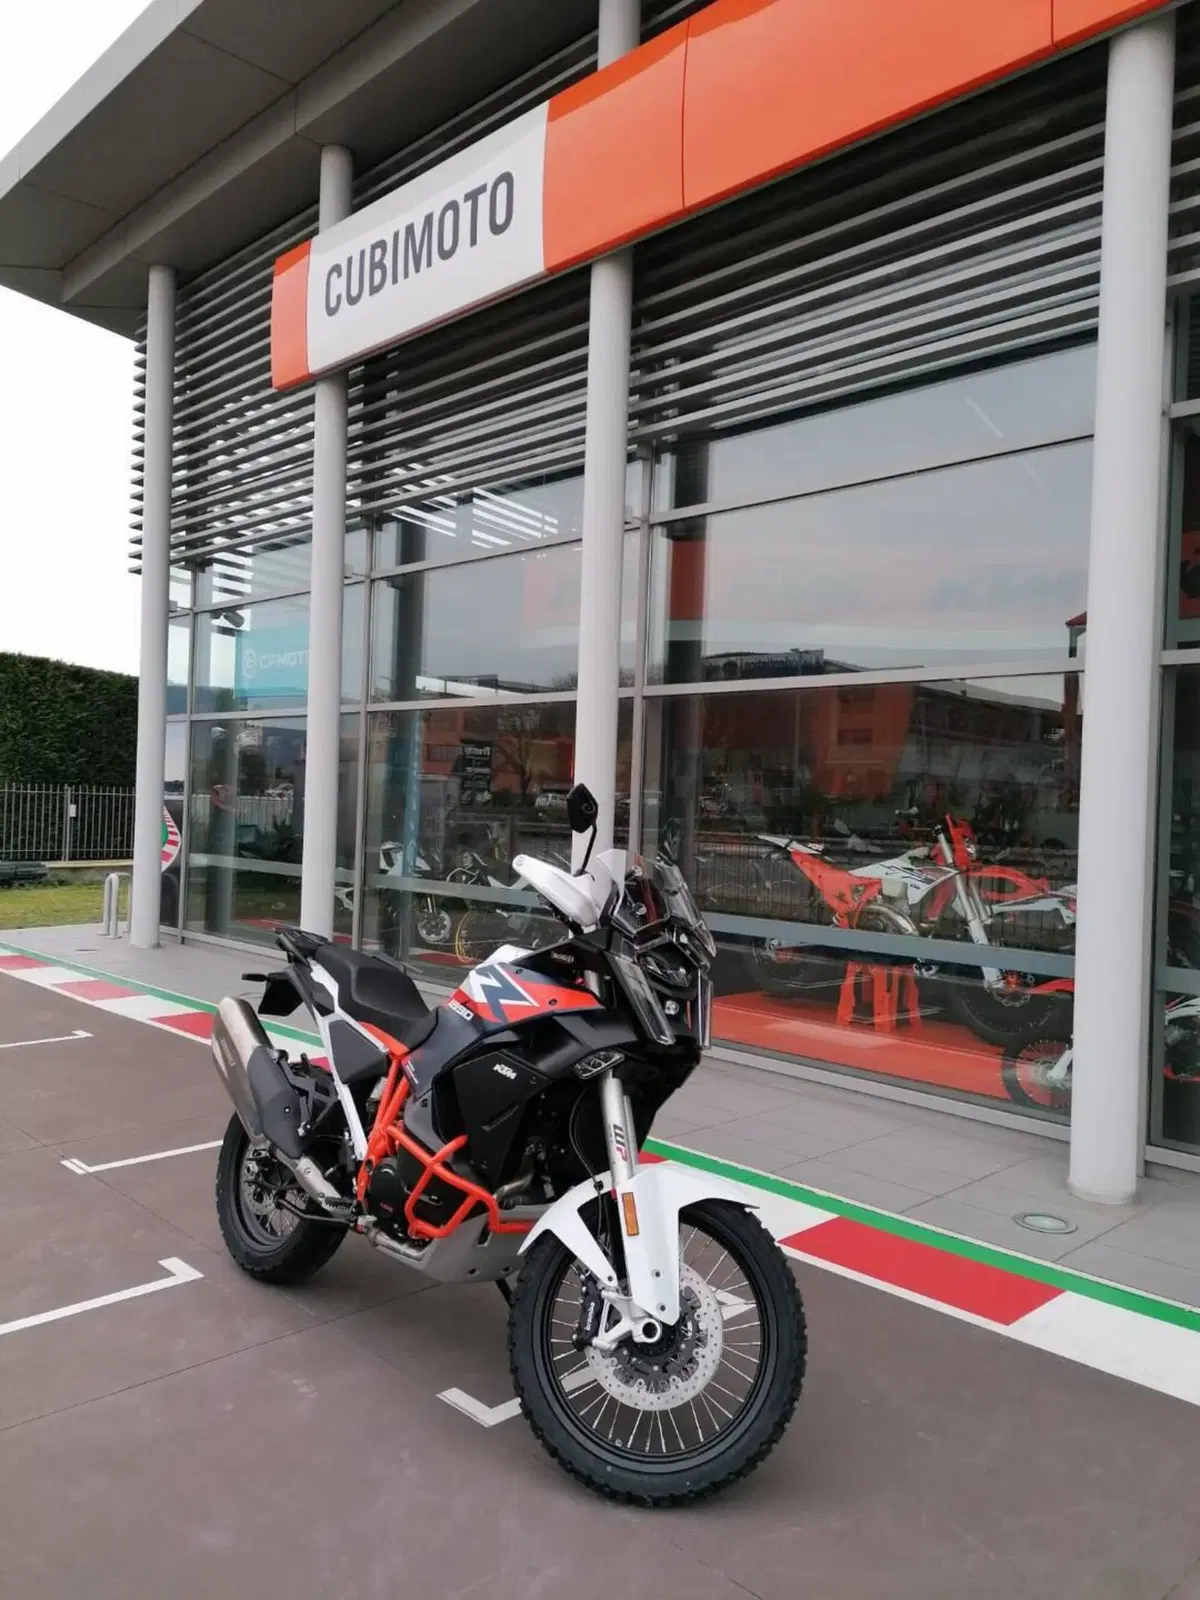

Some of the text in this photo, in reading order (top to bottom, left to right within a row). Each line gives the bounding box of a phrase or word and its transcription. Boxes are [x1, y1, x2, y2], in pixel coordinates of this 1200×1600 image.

[324, 171, 514, 317] CUBIMOTO
[260, 650, 308, 669] CFMOT
[492, 1064, 516, 1080] KTM
